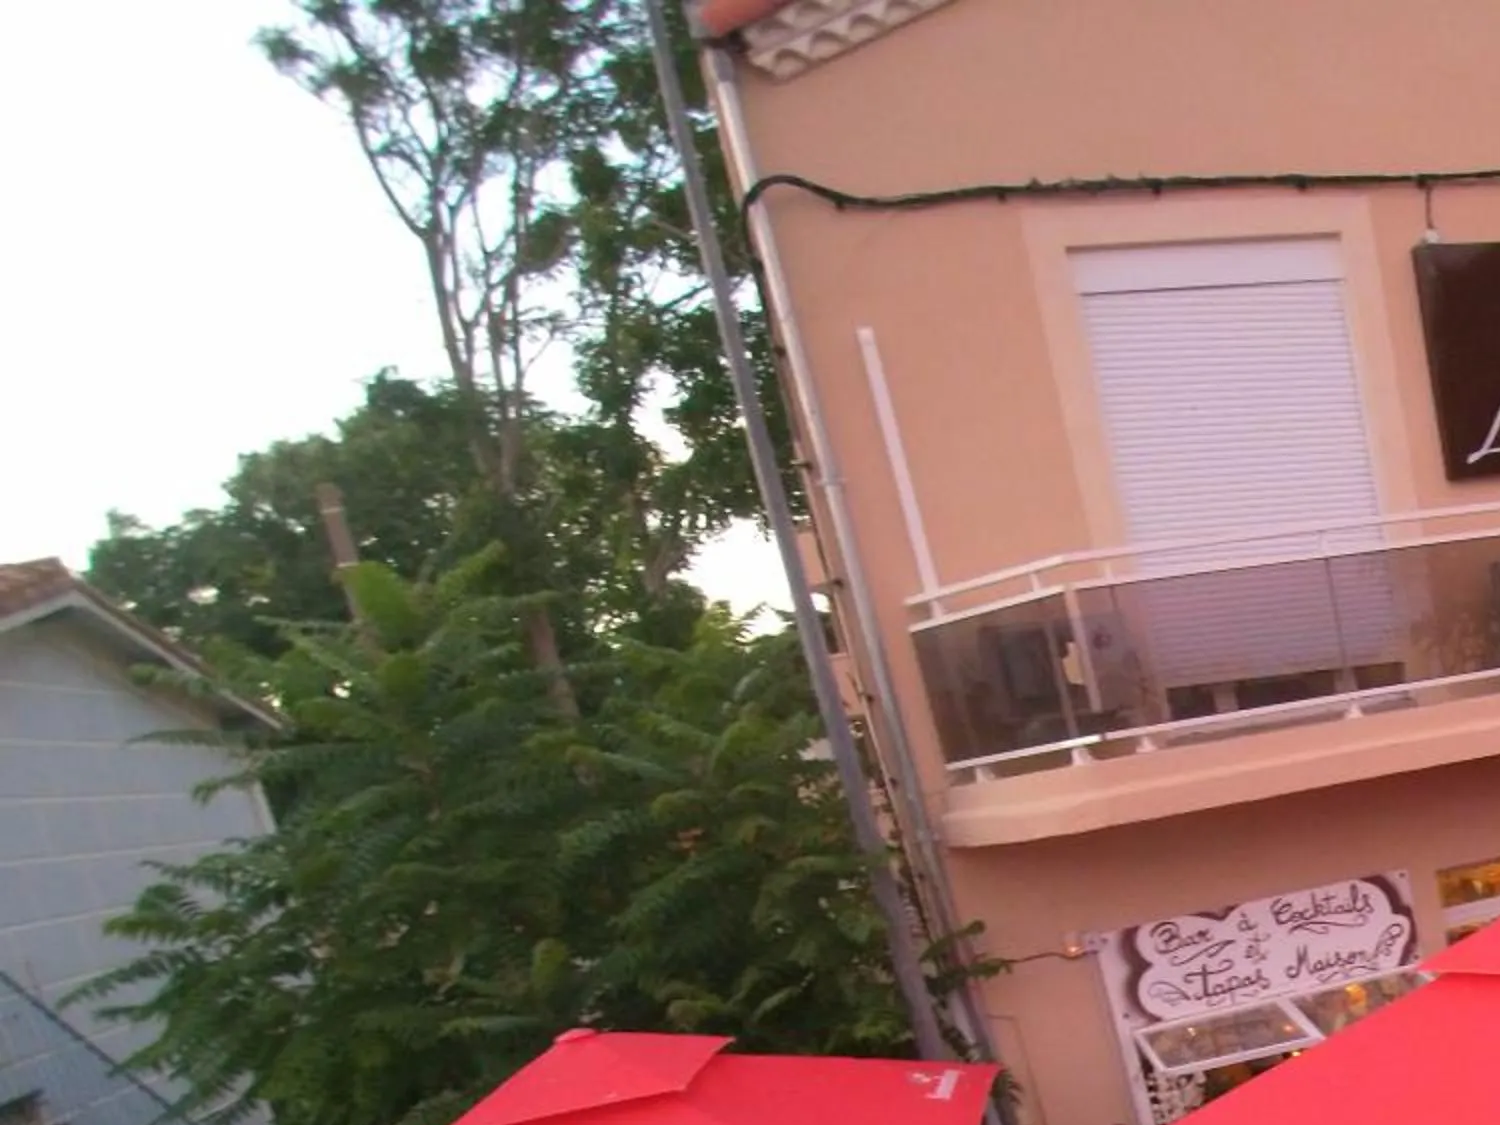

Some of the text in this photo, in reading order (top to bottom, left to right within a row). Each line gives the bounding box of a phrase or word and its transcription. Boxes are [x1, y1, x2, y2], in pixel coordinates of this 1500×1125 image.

[1150, 884, 1375, 955] Bar à Cocktails
[1185, 961, 1270, 1001] Tapas
